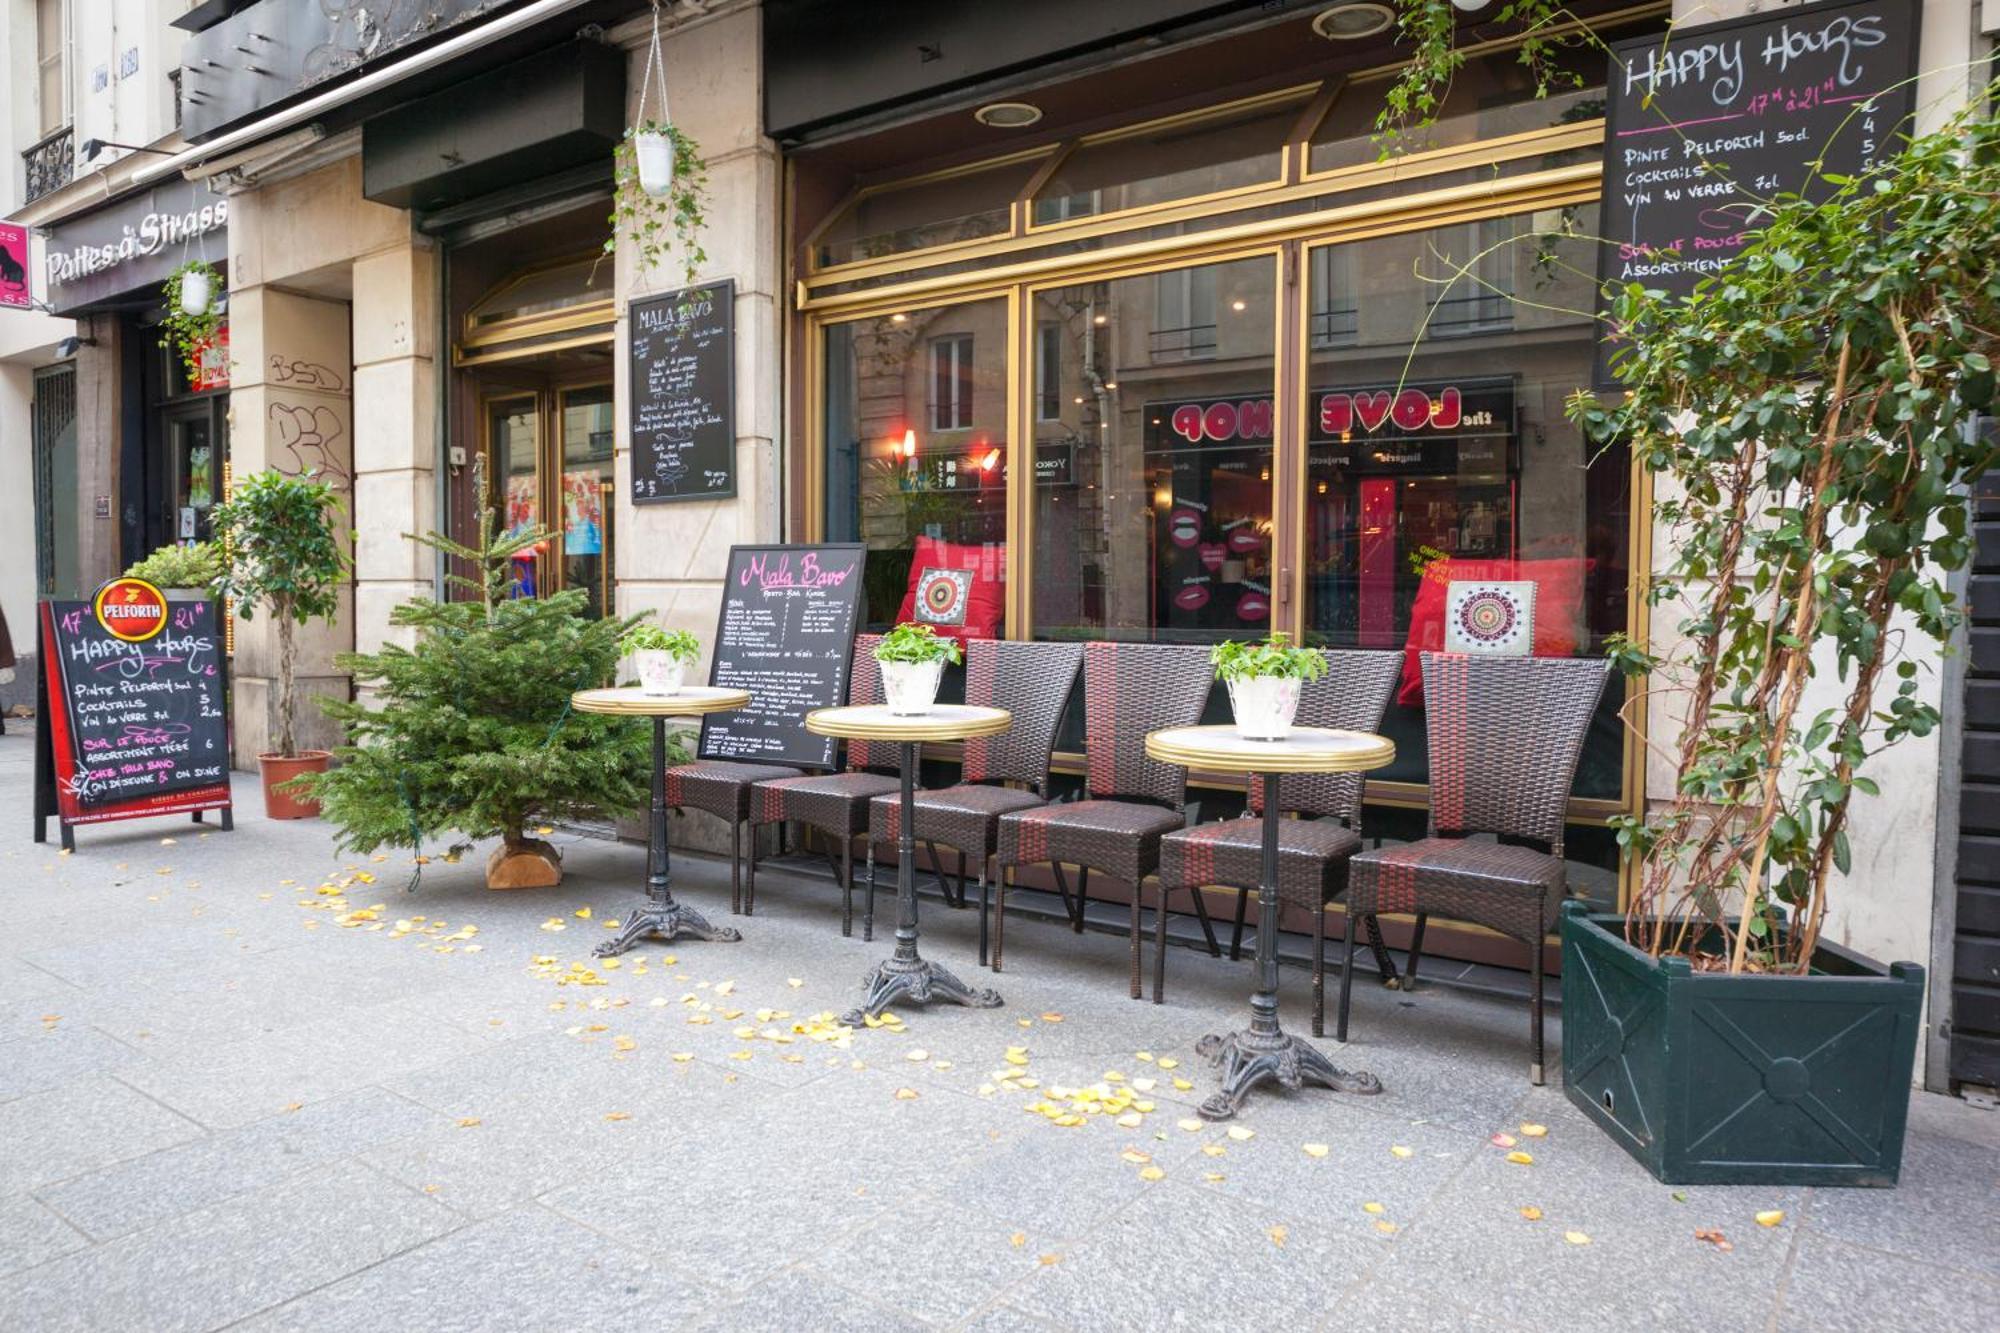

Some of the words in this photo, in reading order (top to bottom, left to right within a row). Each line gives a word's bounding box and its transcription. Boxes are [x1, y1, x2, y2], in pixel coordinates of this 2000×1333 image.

[1625, 40, 1743, 105] HAPPY
[1761, 16, 1886, 86] HOURS
[1684, 131, 1764, 158] PELFORTH
[1863, 117, 1874, 133] 4
[1861, 140, 1875, 154] 5
[1688, 181, 1737, 198] VERRE
[47, 245, 117, 286] Pattes
[140, 200, 228, 256] Strass
[1695, 233, 1745, 249] POUCE
[639, 307, 675, 328] MALA
[741, 553, 794, 588] Mala
[800, 552, 855, 587] Bavo
[104, 605, 161, 618] PELFORTH
[155, 628, 213, 674] HOURS
[200, 694, 210, 704] 5
[205, 739, 213, 750] 6
[121, 763, 144, 775] MALA
[147, 759, 175, 771] BAVO
[176, 770, 191, 780] ON
